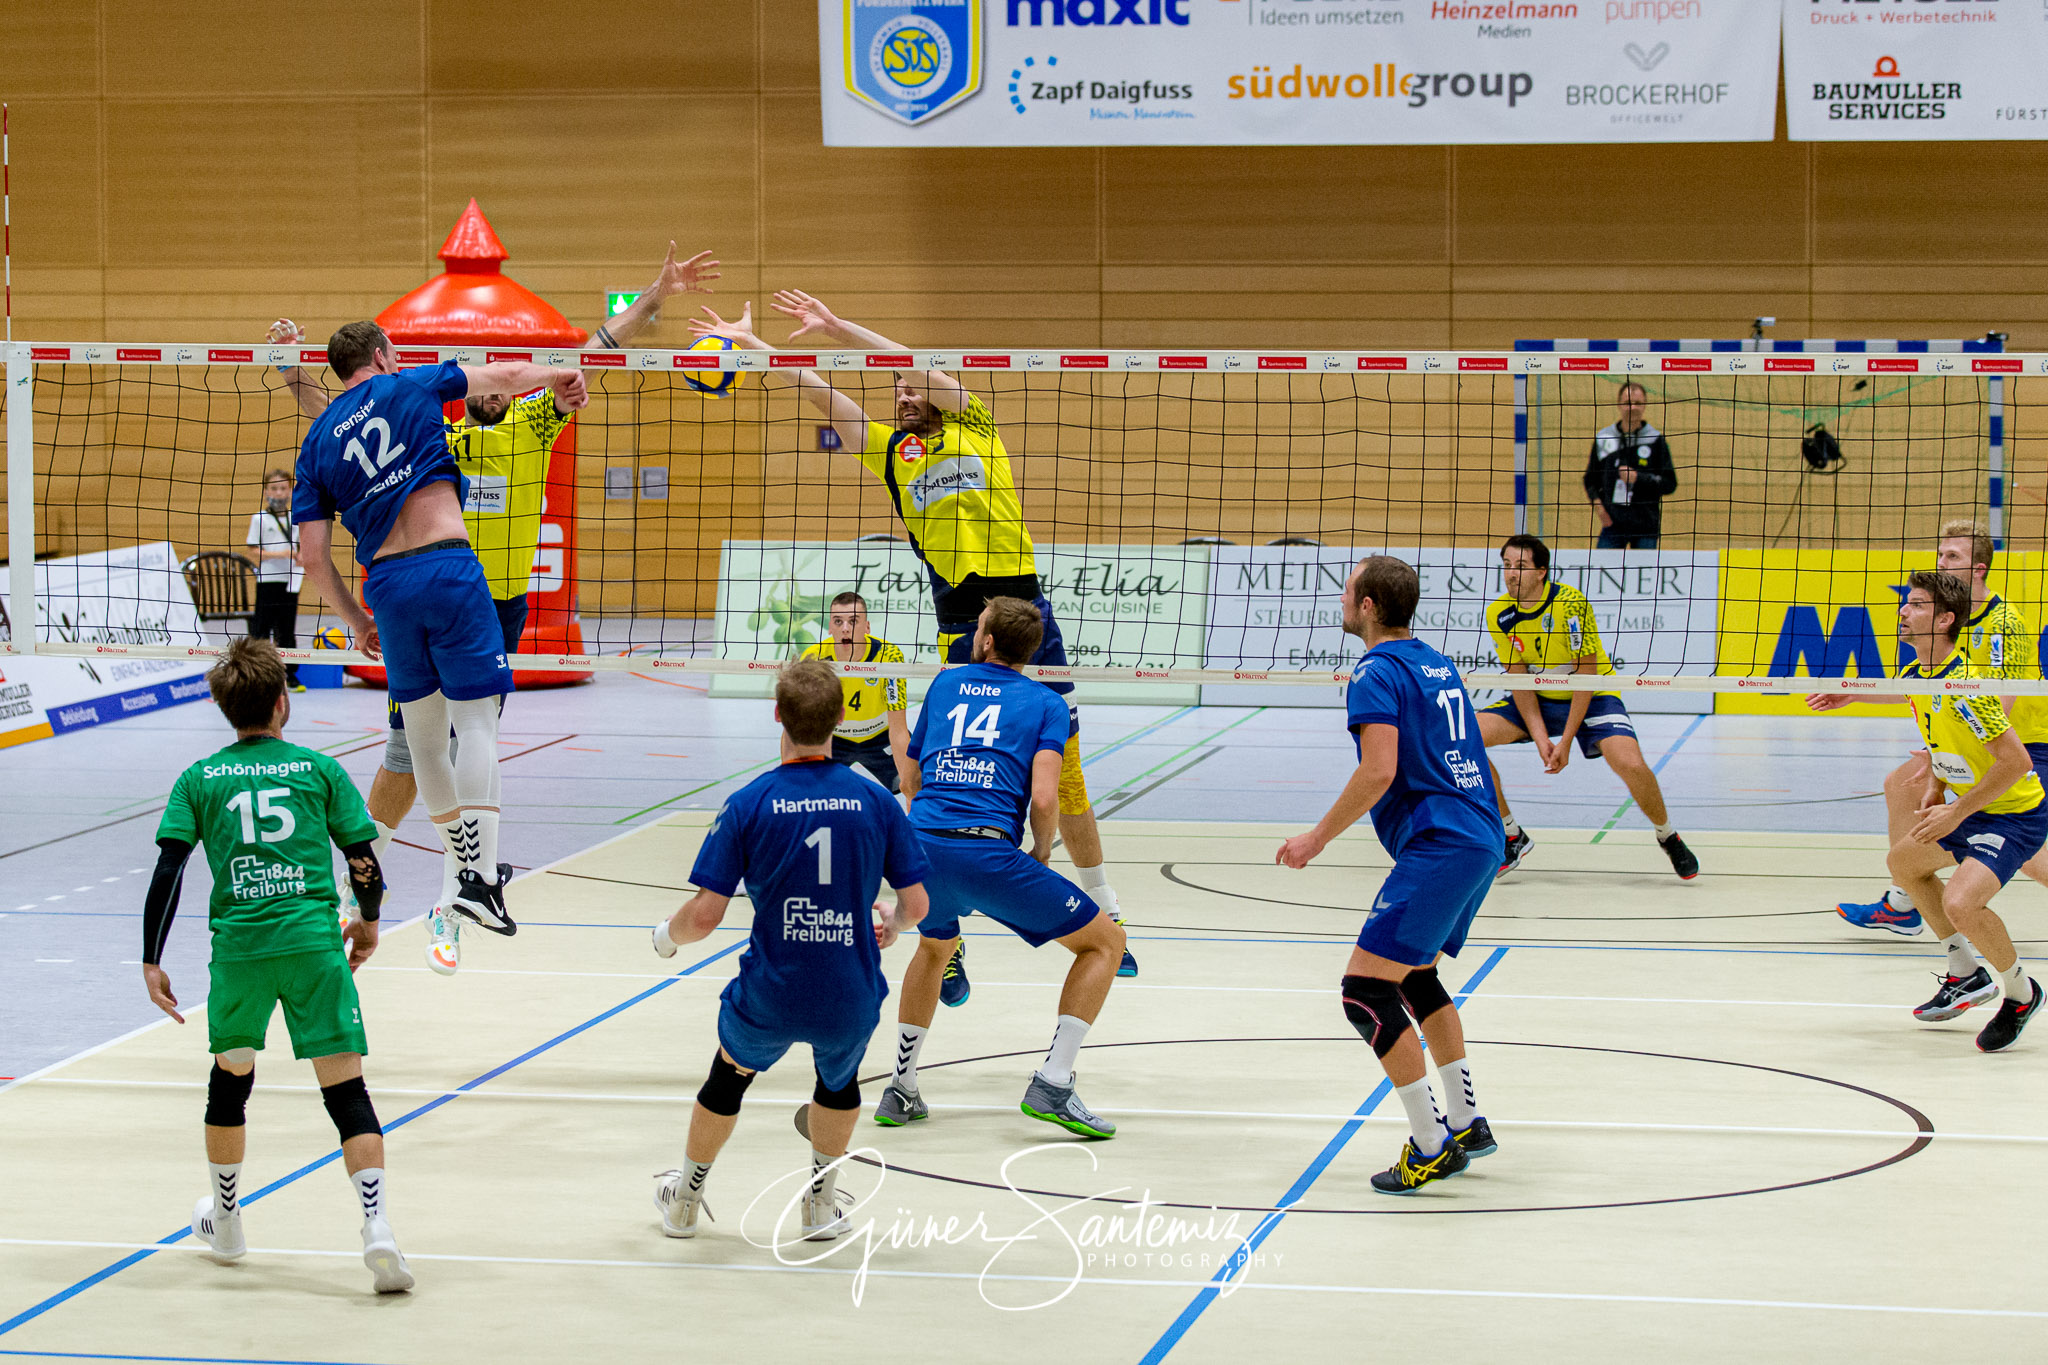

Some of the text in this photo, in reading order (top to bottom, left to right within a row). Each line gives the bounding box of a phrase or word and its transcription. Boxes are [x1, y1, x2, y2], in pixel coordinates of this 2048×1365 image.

[1260, 10, 1404, 25] Ideen umsetzen
[1431, 1, 1578, 20] Heinzelmann
[1605, 0, 1701, 24] pumpen
[1810, 12, 1858, 25] Druck
[1880, 10, 1997, 24] Werbetechnik
[1477, 25, 1532, 38] Medien
[1031, 81, 1192, 103] Zapf Daigfuss
[1566, 83, 1729, 105] BROCKERHOF
[1828, 103, 1945, 120] SERVICES
[333, 398, 376, 438] Gensitz
[342, 416, 406, 479] 12
[469, 490, 500, 500] igfuss
[1236, 562, 1431, 593] MEINE
[1447, 563, 1478, 593] &
[1089, 601, 1163, 614] CUISINE
[1420, 664, 1452, 681] Dinges
[959, 683, 1001, 697] Nolte
[848, 690, 862, 712] 4
[946, 703, 1002, 747] 14
[1436, 687, 1466, 742] 17
[203, 761, 312, 779] Schönhagen
[935, 768, 994, 789] Freiburg
[226, 787, 296, 845] 15
[772, 798, 862, 814] Hartmann
[804, 827, 832, 885] 1
[232, 880, 307, 900] Freiburg
[783, 925, 855, 947] Freiburg
